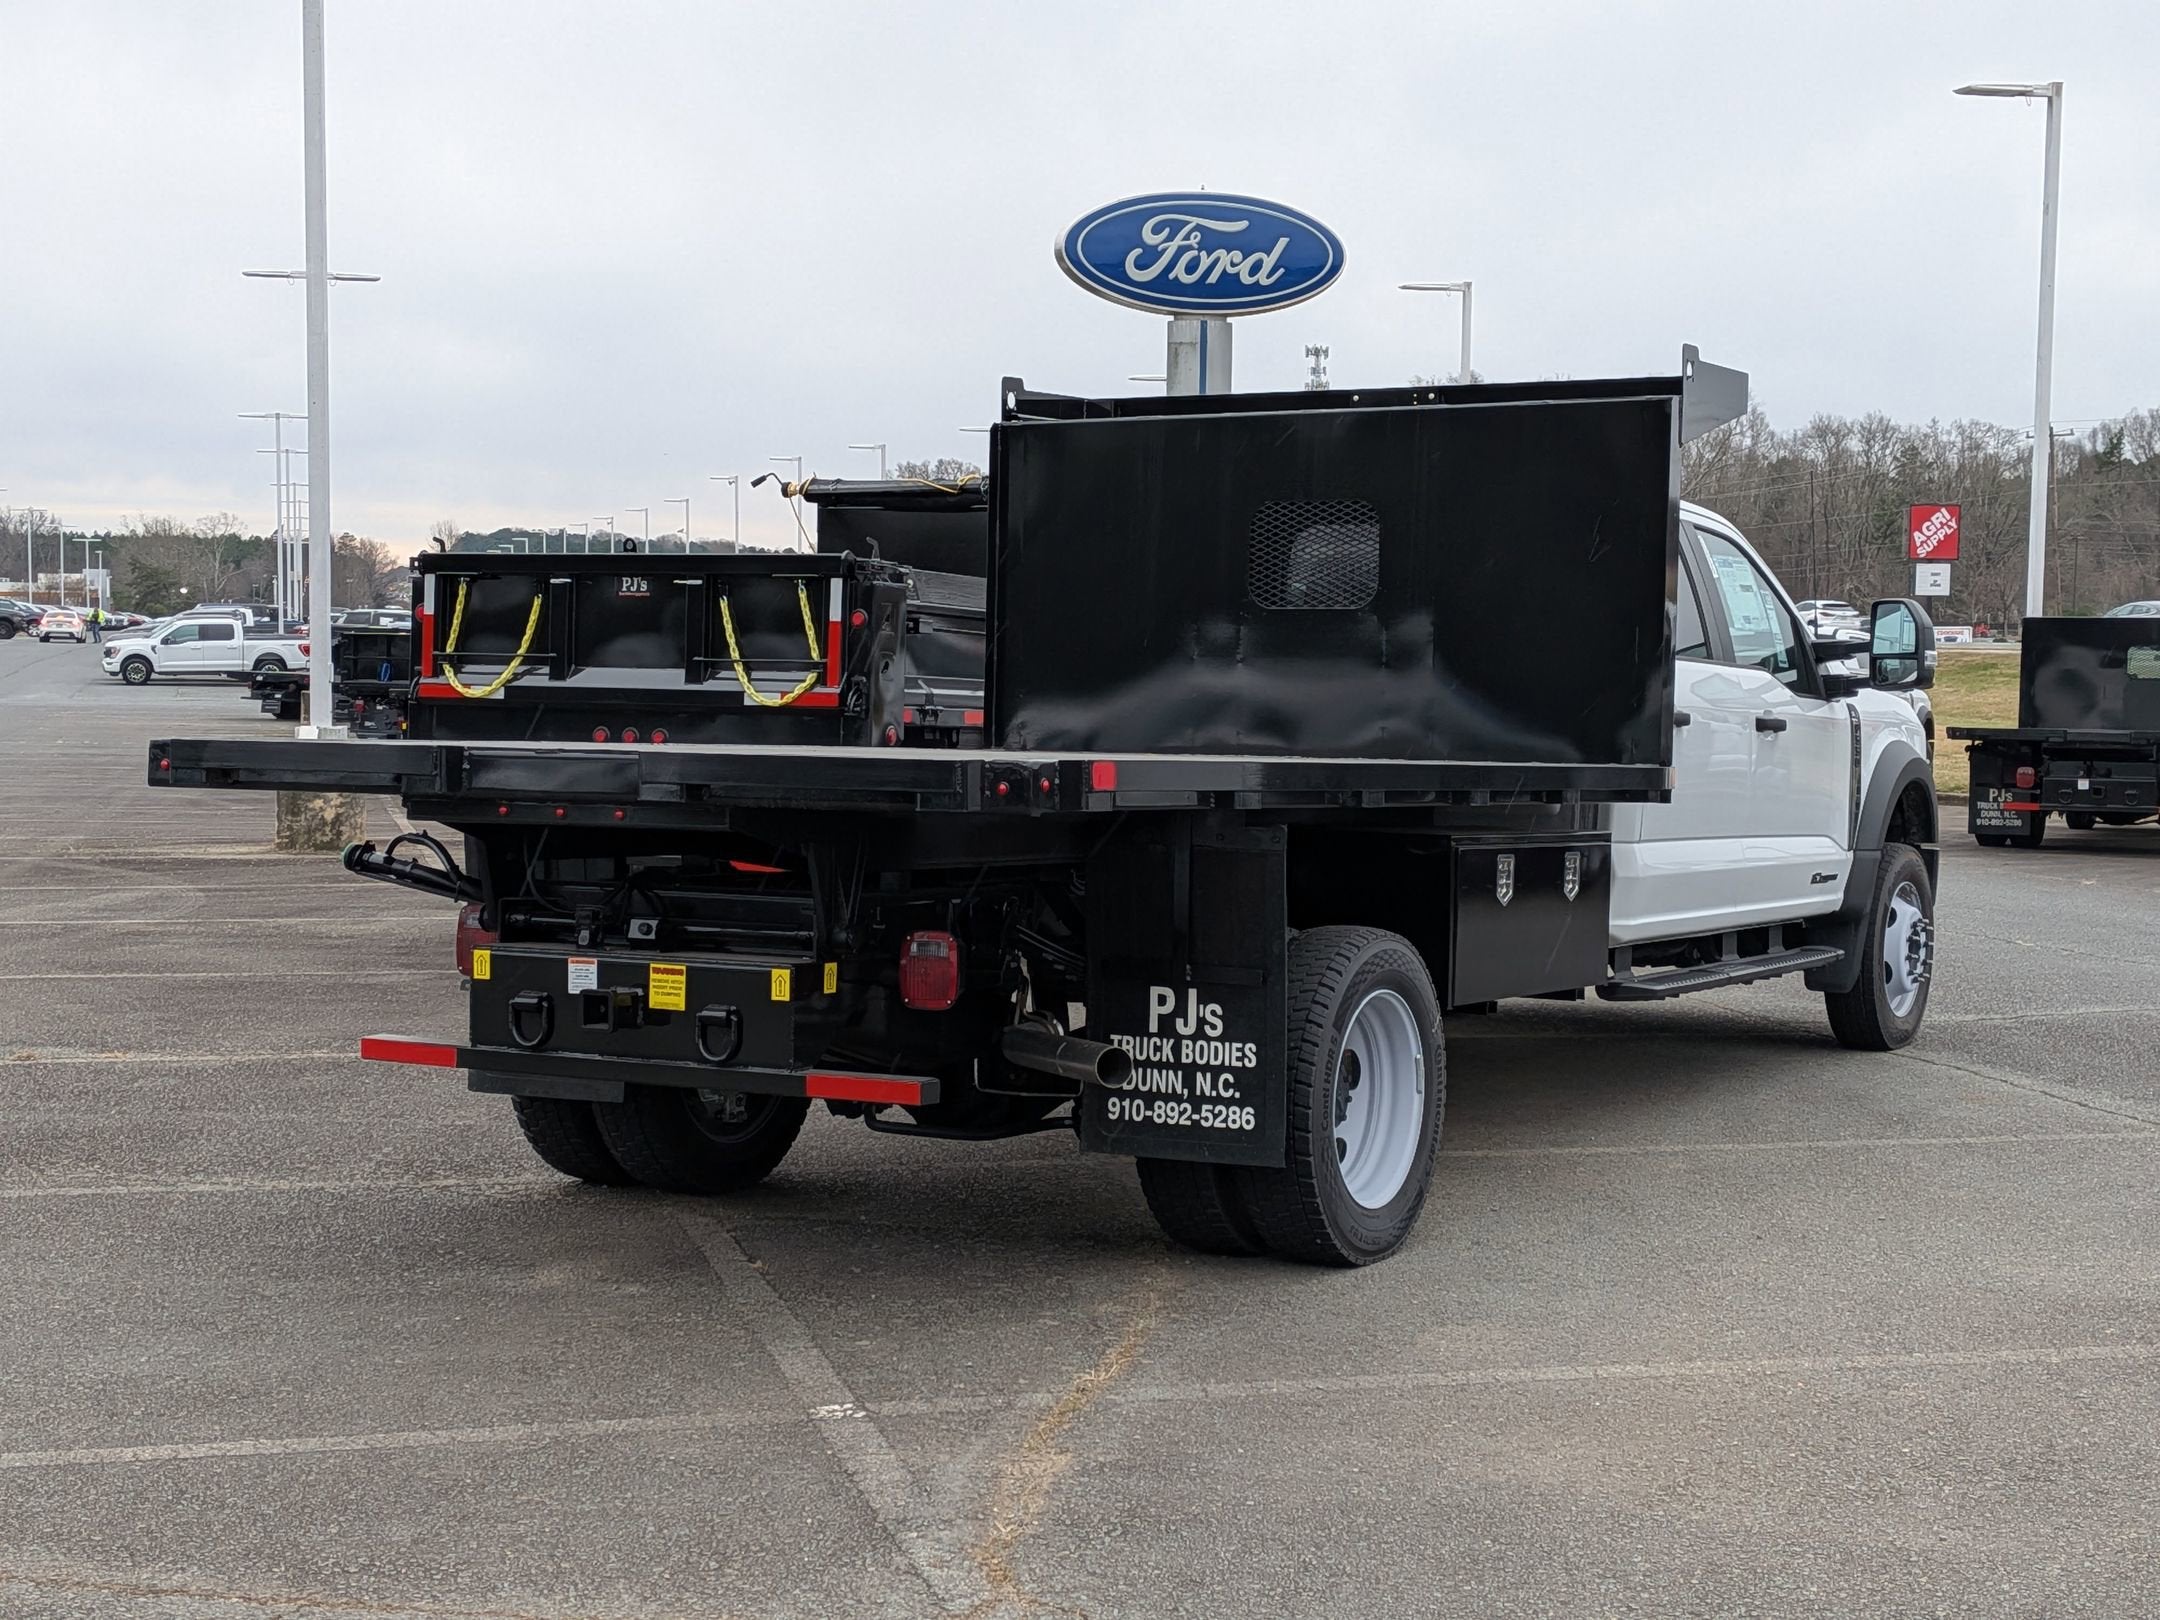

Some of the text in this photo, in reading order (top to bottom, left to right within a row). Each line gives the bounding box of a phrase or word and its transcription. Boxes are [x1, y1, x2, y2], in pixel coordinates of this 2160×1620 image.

[1125, 213, 1290, 286] Ford
[1913, 507, 1951, 547] AGRI
[1916, 517, 1958, 558] SUPPLY
[621, 576, 648, 592] PJ's
[1149, 986, 1223, 1037] PJ's
[1110, 1034, 1257, 1068] TRUCK BODIES
[1122, 1067, 1240, 1100] DUNN, N.C.
[1107, 1096, 1256, 1130] 910-892-5286
